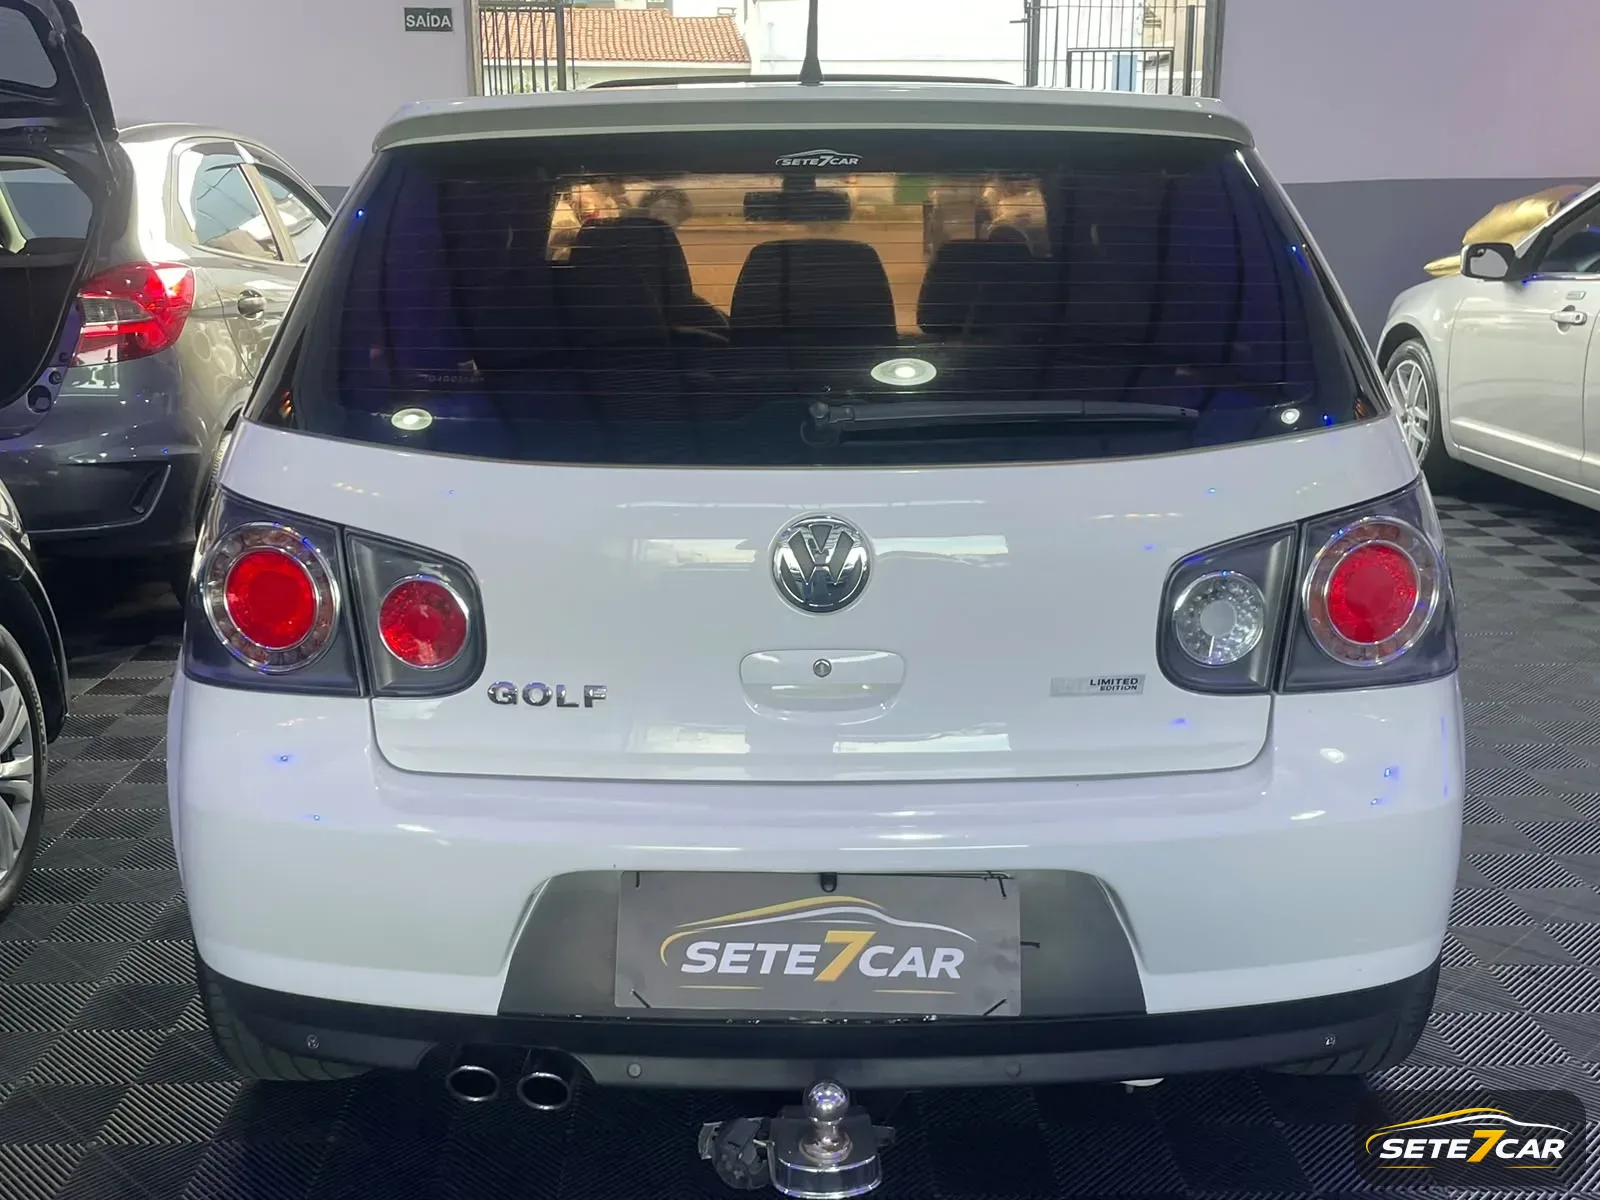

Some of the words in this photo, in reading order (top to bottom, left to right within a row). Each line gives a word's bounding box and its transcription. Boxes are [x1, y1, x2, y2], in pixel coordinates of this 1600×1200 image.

[406, 12, 452, 28] SAÍDA
[781, 155, 859, 167] SETE7CAR
[1089, 677, 1139, 686] LIMITED
[487, 681, 607, 708] GOLF
[680, 929, 964, 982] SETE7CAR
